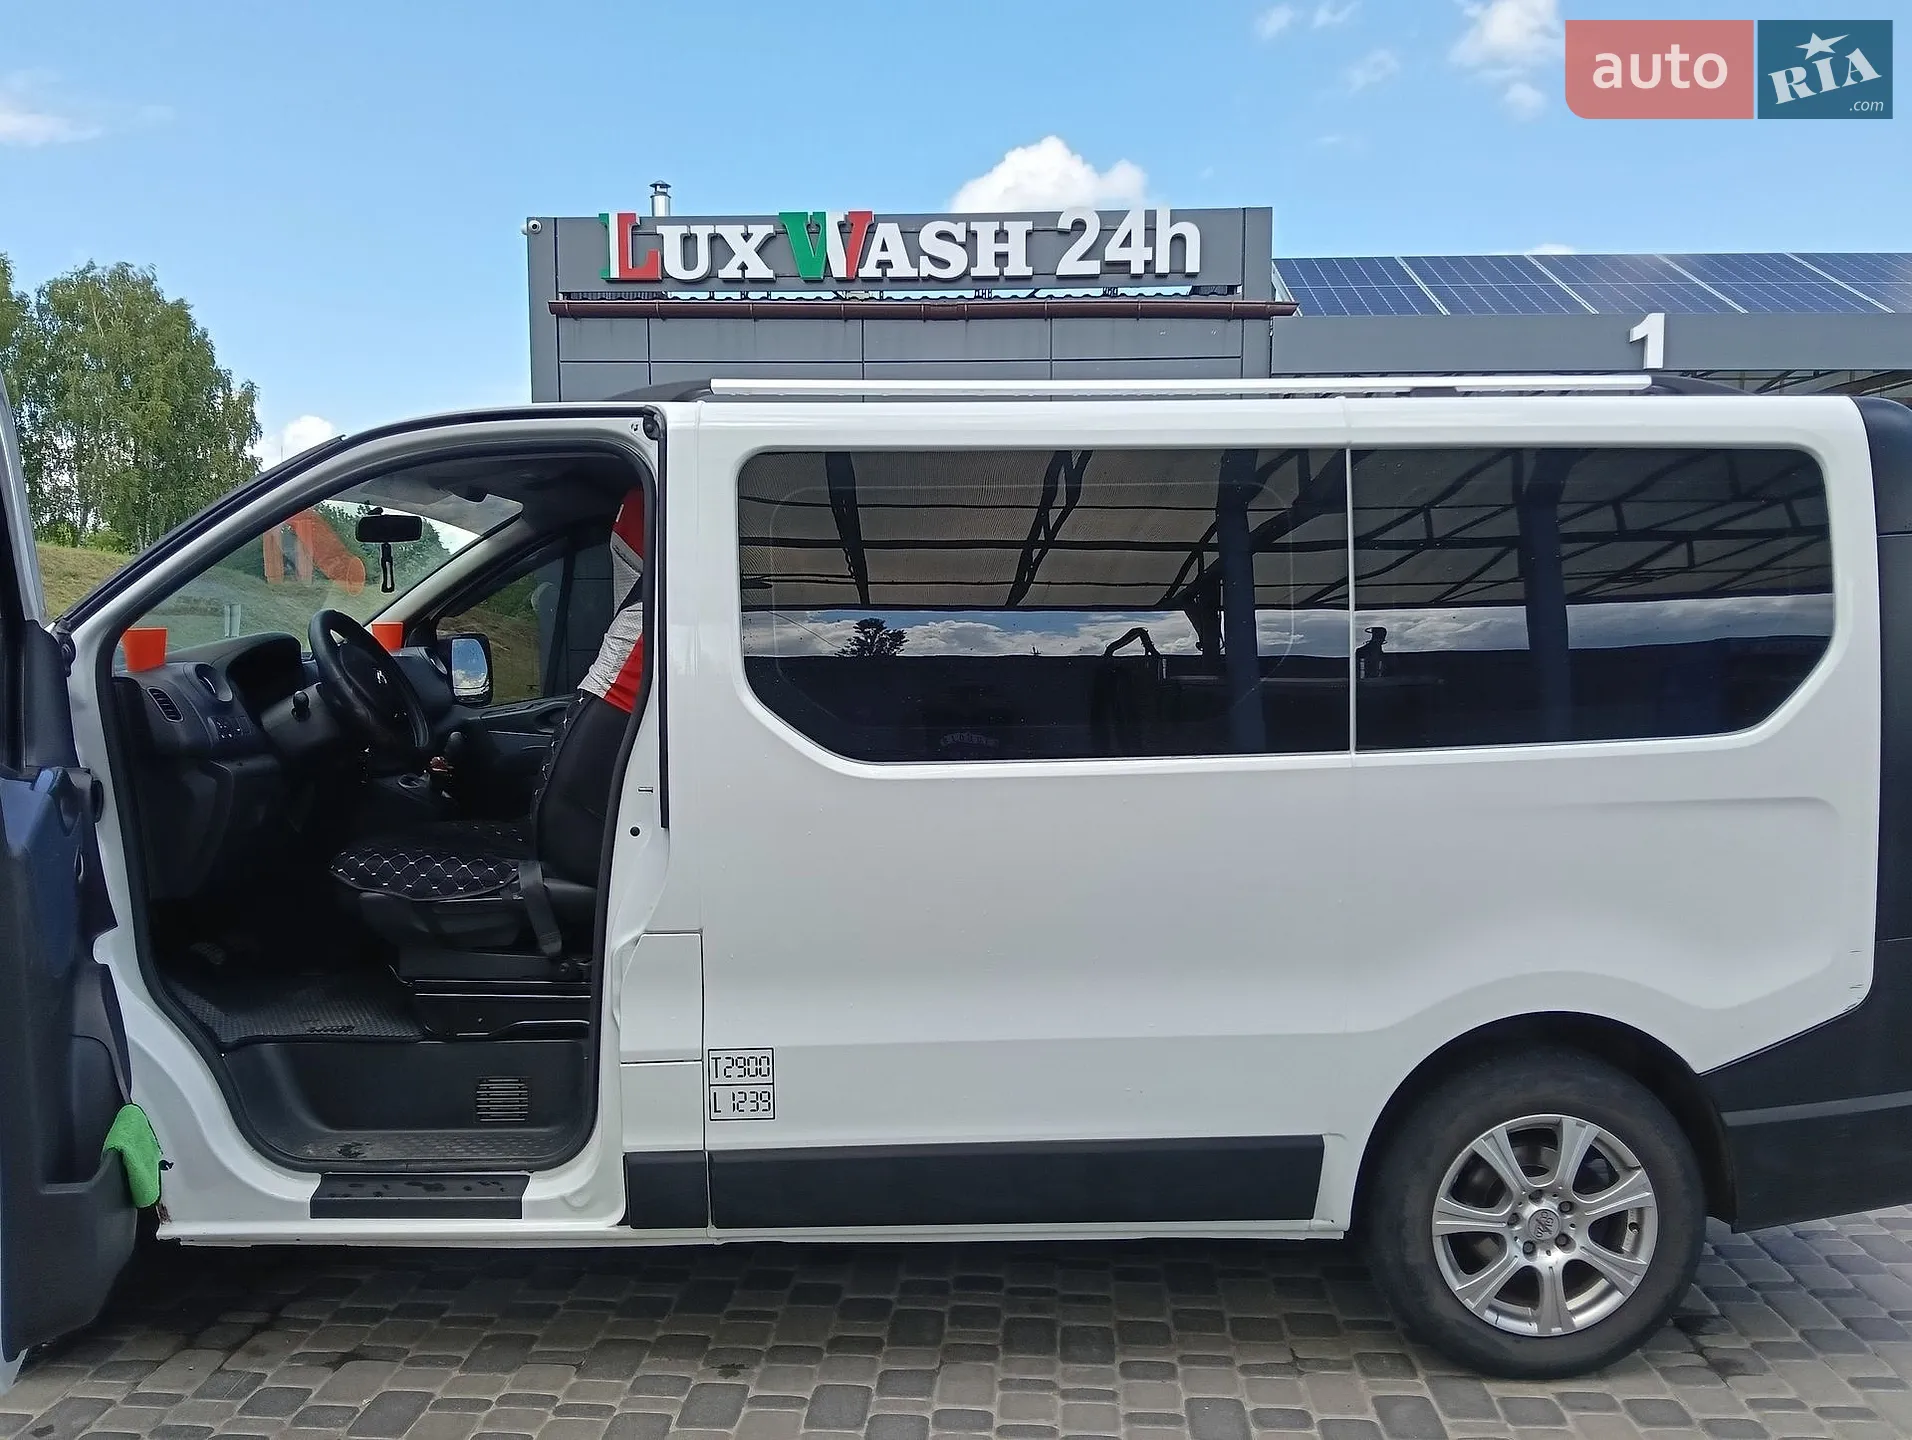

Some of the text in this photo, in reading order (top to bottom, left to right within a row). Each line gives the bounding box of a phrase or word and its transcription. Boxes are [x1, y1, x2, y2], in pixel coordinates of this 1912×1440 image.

[1056, 206, 1200, 277] 24h
[1629, 313, 1665, 370] 1
[711, 1055, 770, 1078] T2900
